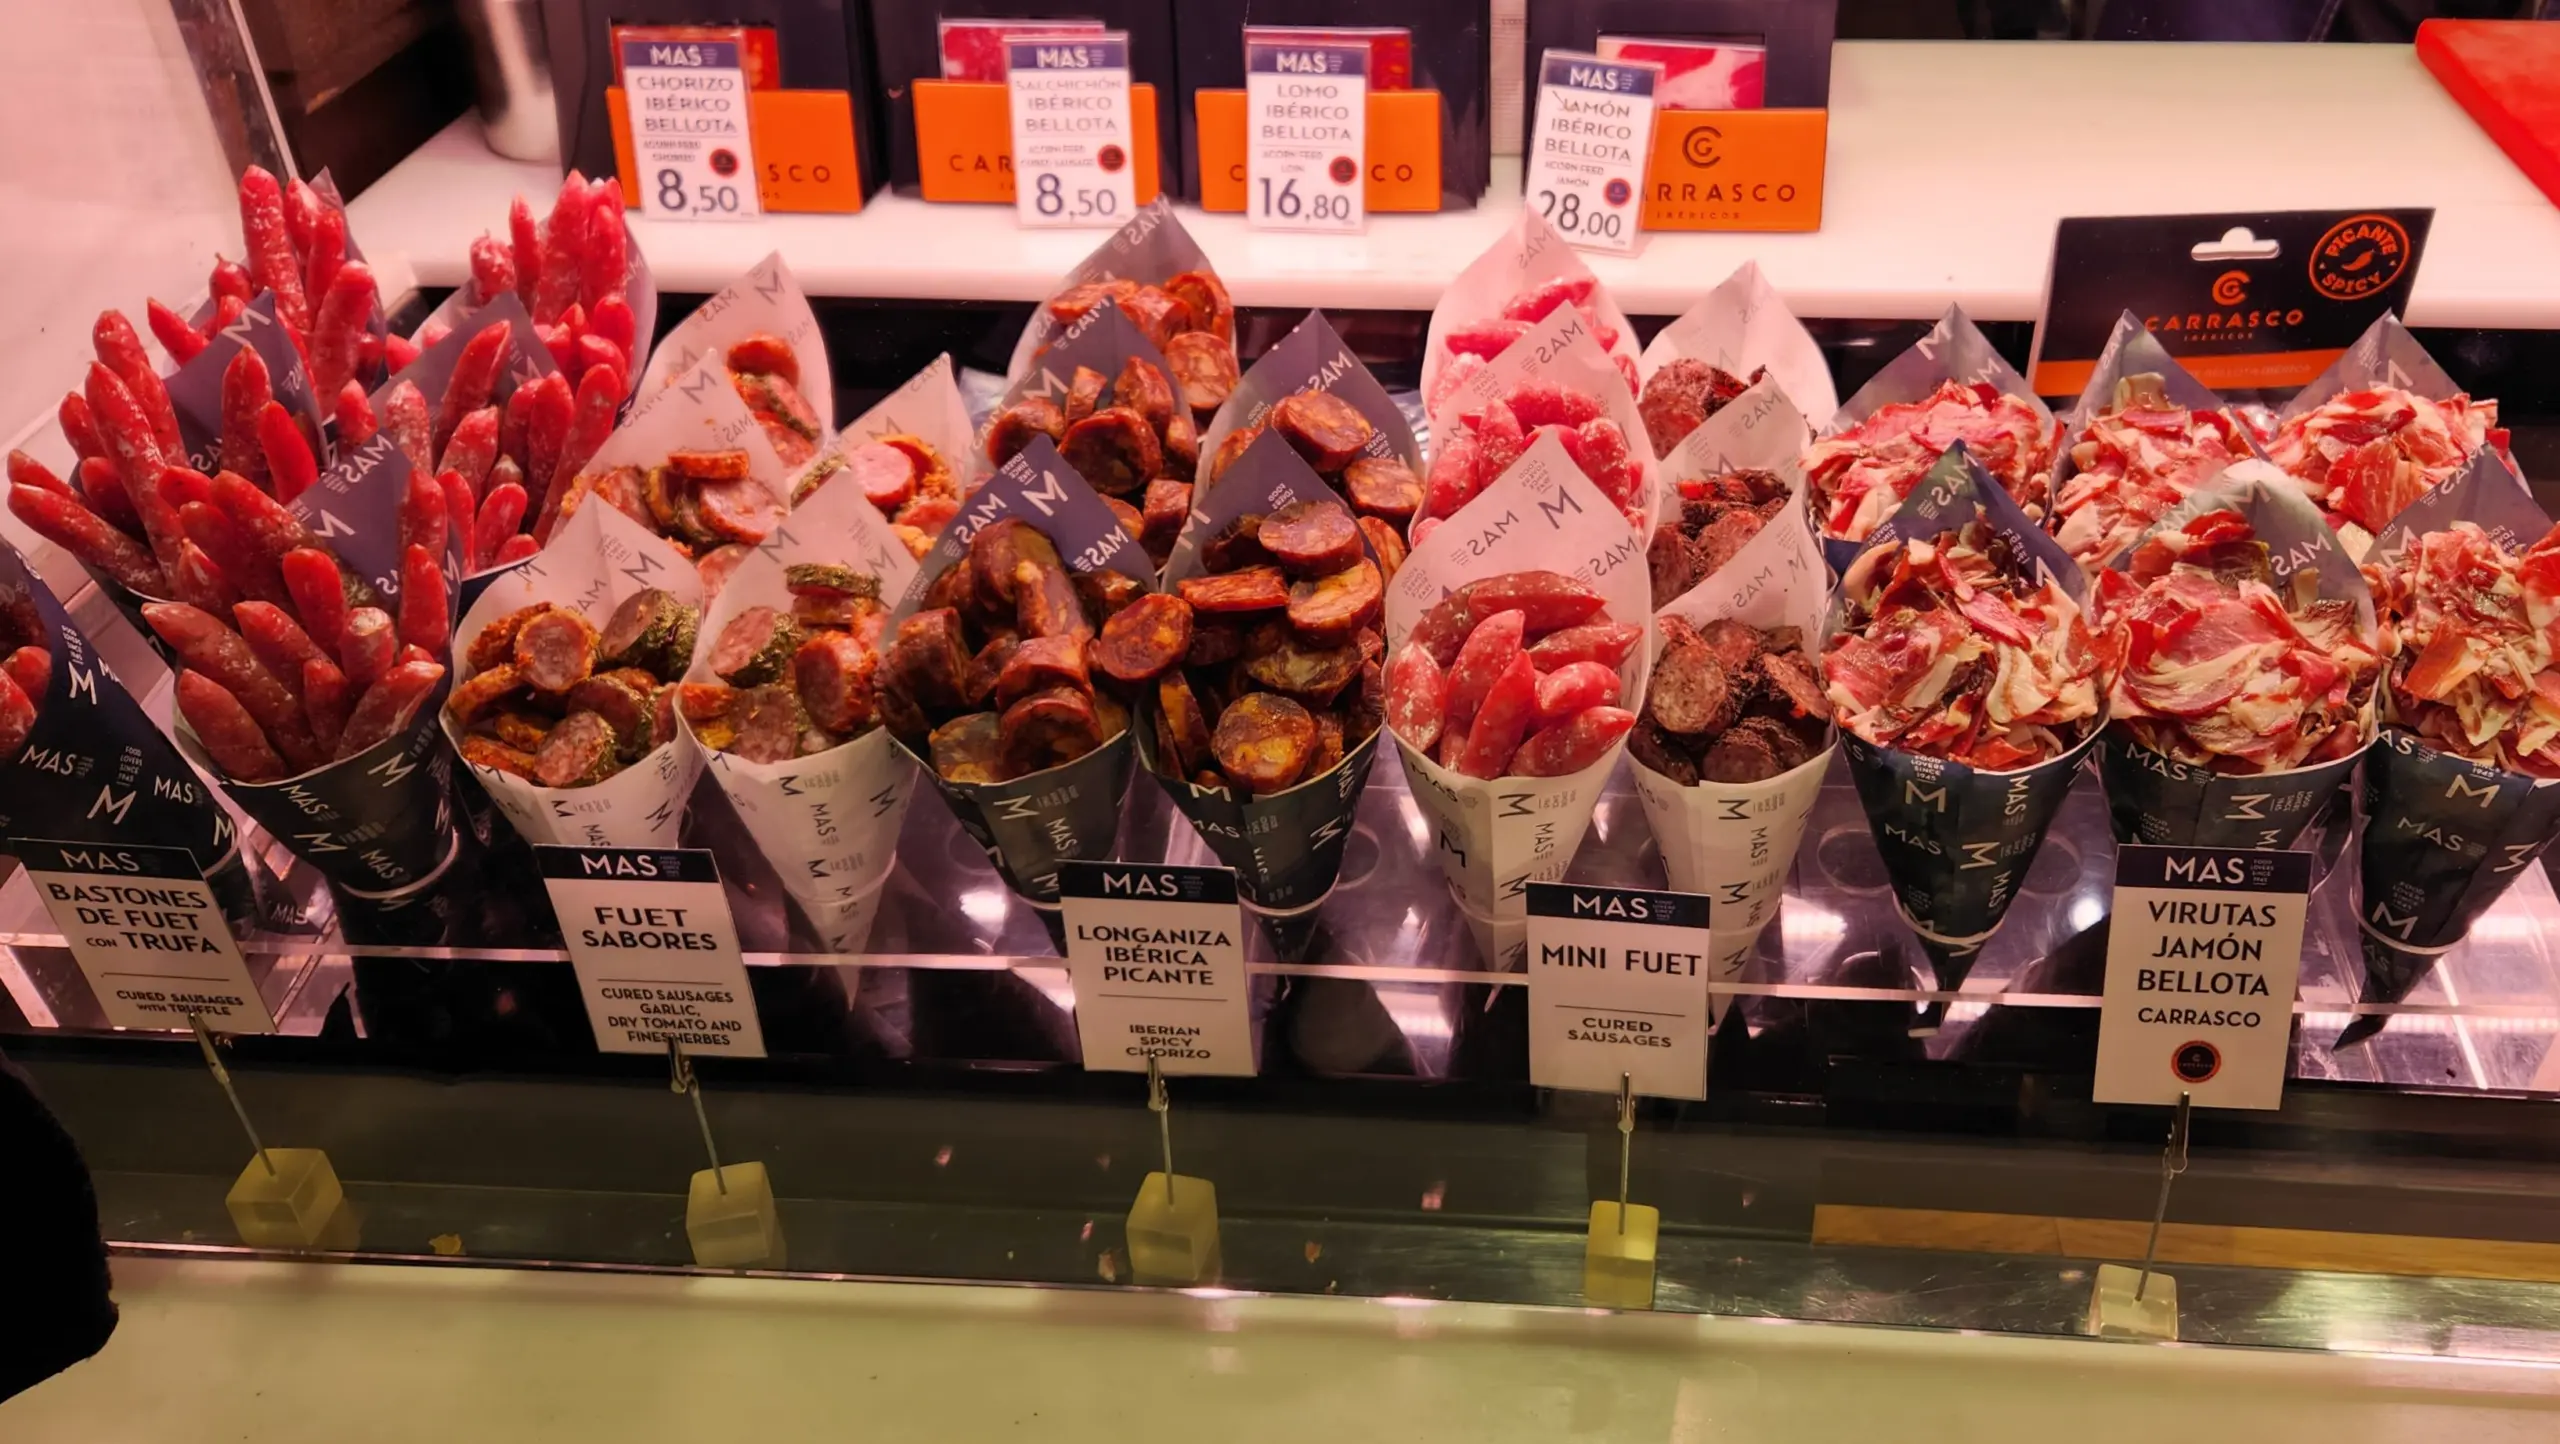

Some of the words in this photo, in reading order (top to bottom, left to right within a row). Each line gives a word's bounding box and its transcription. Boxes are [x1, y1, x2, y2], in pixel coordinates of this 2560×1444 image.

[650, 44, 702, 66] MAS
[1036, 46, 1089, 68] MAS
[1276, 52, 1327, 73] MAS
[637, 76, 733, 92] CHORIZO
[1570, 66, 1620, 90] MAS
[645, 94, 731, 112] IBÉRICO
[1028, 94, 1112, 111] IBÉRICO
[1277, 84, 1338, 99] LOMO
[1265, 102, 1349, 120] IBÉRICO
[1560, 97, 1630, 119] JAMÓN
[644, 117, 737, 133] BELLOTA
[1025, 117, 1117, 132] BELLOTA
[1262, 125, 1351, 142] BELLOTA
[1551, 116, 1631, 140] IBÉRICO
[1545, 138, 1631, 162] BELLOTA
[657, 168, 739, 216] 8,50
[1035, 172, 1117, 221] 8,50
[1259, 177, 1350, 223] 16,80
[1646, 183, 1796, 203] RRASCO
[2325, 223, 2398, 256] PICANTE
[2322, 271, 2380, 293] SPICY
[2145, 308, 2304, 333] CARRASCO
[68, 661, 97, 706] M
[19, 745, 77, 776] MAS
[367, 752, 418, 787] M
[655, 750, 676, 781] MAS
[1911, 759, 1945, 771] LOVERS
[1914, 765, 1941, 776] SINCE
[2127, 742, 2189, 782] MAS
[153, 775, 194, 804] MAS
[779, 774, 805, 797] M
[1411, 762, 1458, 802] MAS
[2445, 774, 2501, 808] M
[87, 784, 137, 826] M
[279, 784, 329, 816] MAS
[869, 784, 898, 818] M
[1499, 793, 1537, 818] M
[1905, 780, 1947, 813] M
[2004, 774, 2032, 816] MAS
[2225, 793, 2272, 820] M
[552, 800, 576, 819] M
[645, 801, 674, 833] M
[993, 795, 1040, 820] M
[1718, 799, 1751, 821] M
[810, 803, 837, 837] MAS
[293, 832, 349, 853] M
[1045, 817, 1078, 852] MAS
[1310, 815, 1344, 851] M
[1535, 821, 1556, 854] MAS
[1751, 826, 1769, 859] MAS
[1884, 823, 1943, 856] MAS
[2397, 817, 2465, 852] MAS
[1440, 829, 1467, 868] M
[1960, 841, 2001, 870] M
[2493, 841, 2541, 873] M
[60, 850, 140, 872] MAS
[360, 849, 404, 880] MAS
[581, 854, 658, 877] MAS
[807, 859, 831, 879] M
[2164, 856, 2245, 885] MAS
[47, 883, 208, 909] BASTONES
[1103, 872, 1179, 896] MAS
[1720, 881, 1750, 905] M
[1988, 870, 2013, 909] MAS
[594, 907, 688, 928] FUET
[1573, 893, 1648, 919] MAS
[2148, 901, 2277, 927] VIRUTAS
[76, 907, 123, 926] DE
[124, 909, 199, 931] FUET
[2372, 902, 2419, 940] M
[86, 937, 117, 948] CON
[119, 932, 222, 955] TRUFA
[582, 930, 717, 951] SABORES
[1077, 925, 1231, 947] LONGANIZA
[2152, 932, 2262, 961] JAMÓN
[1105, 944, 1208, 966] IBÉRICA
[1541, 943, 1606, 969] MINI
[1625, 949, 1702, 976] FUET
[1723, 946, 1748, 976] M
[1104, 966, 1214, 986] PICANTE
[2137, 969, 2269, 996] BELLOTA
[116, 990, 166, 1002] CURED
[170, 993, 244, 1007] SAUSAGES
[601, 987, 653, 1000] CURED
[657, 989, 734, 1003] SAUSAGES
[136, 1003, 166, 1013] WITH
[169, 1004, 232, 1017] TRUFFLE
[640, 1003, 701, 1017] GARLIC,
[2138, 1007, 2261, 1028] CARRASCO
[608, 1016, 637, 1028] DRY
[643, 1017, 707, 1031] TOMATO
[711, 1020, 742, 1031] AND
[1129, 1024, 1200, 1036] IBERIAN
[1582, 1017, 1653, 1033] CURED
[626, 1030, 668, 1043] FINES
[678, 1034, 731, 1046] HERBES
[1140, 1036, 1192, 1047] SPICY
[1567, 1029, 1672, 1048] SAUSAGES
[1125, 1047, 1211, 1059] CHORIZO
